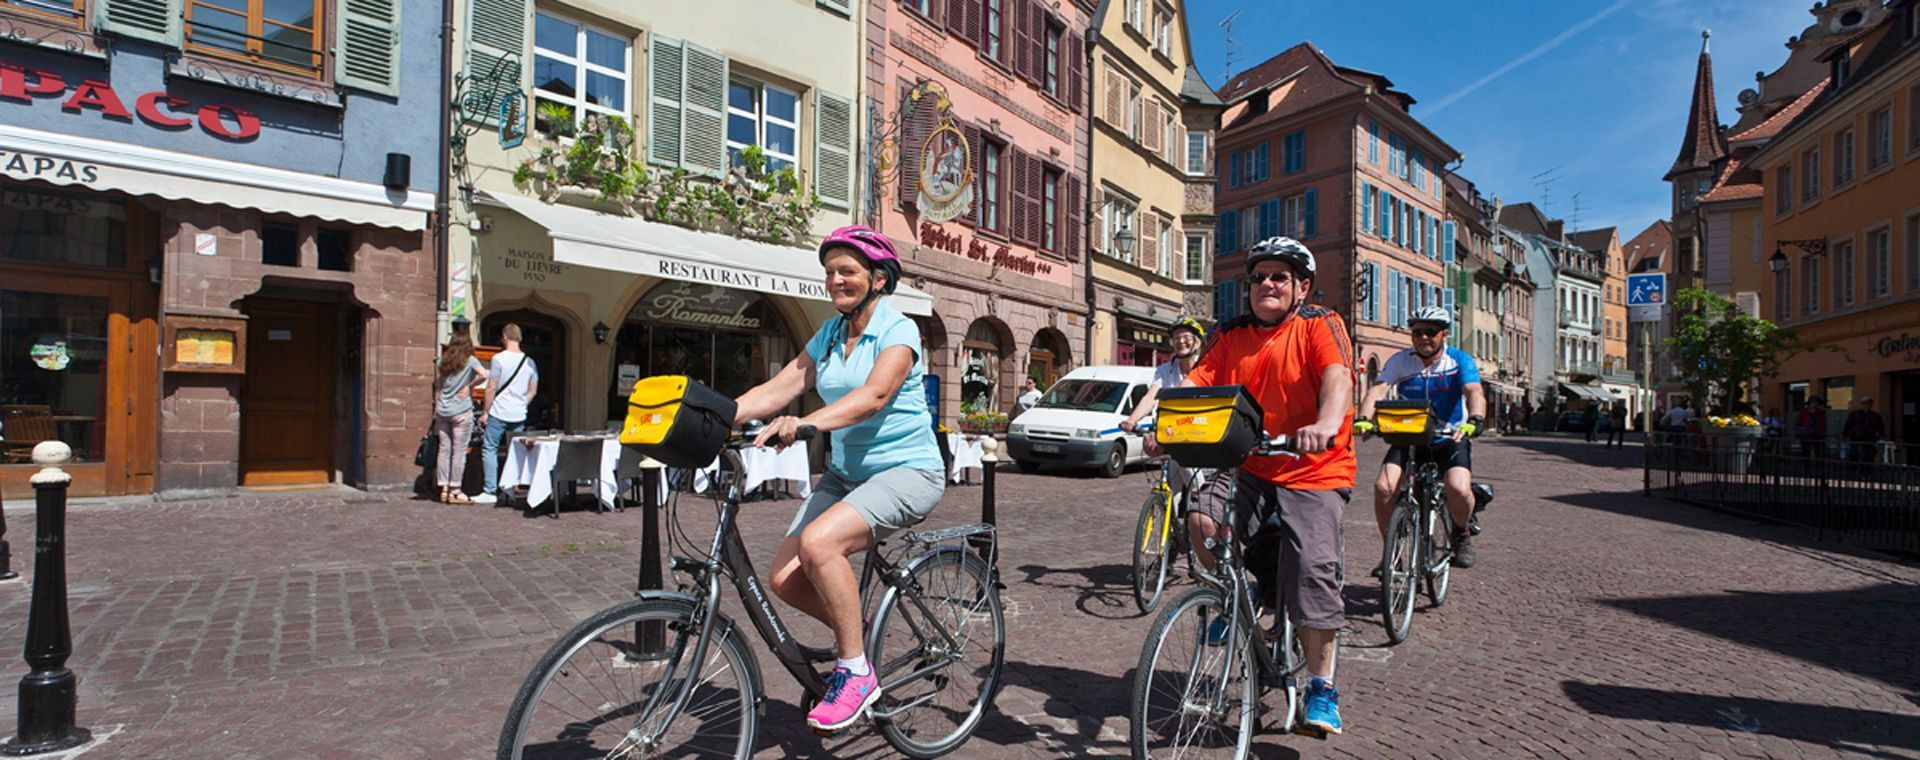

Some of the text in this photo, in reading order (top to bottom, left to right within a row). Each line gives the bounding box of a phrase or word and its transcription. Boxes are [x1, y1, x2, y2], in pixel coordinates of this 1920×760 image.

[0, 63, 261, 138] PACO
[659, 260, 830, 298] RESTAURANT LA ROM
[647, 294, 761, 329] Romantica
